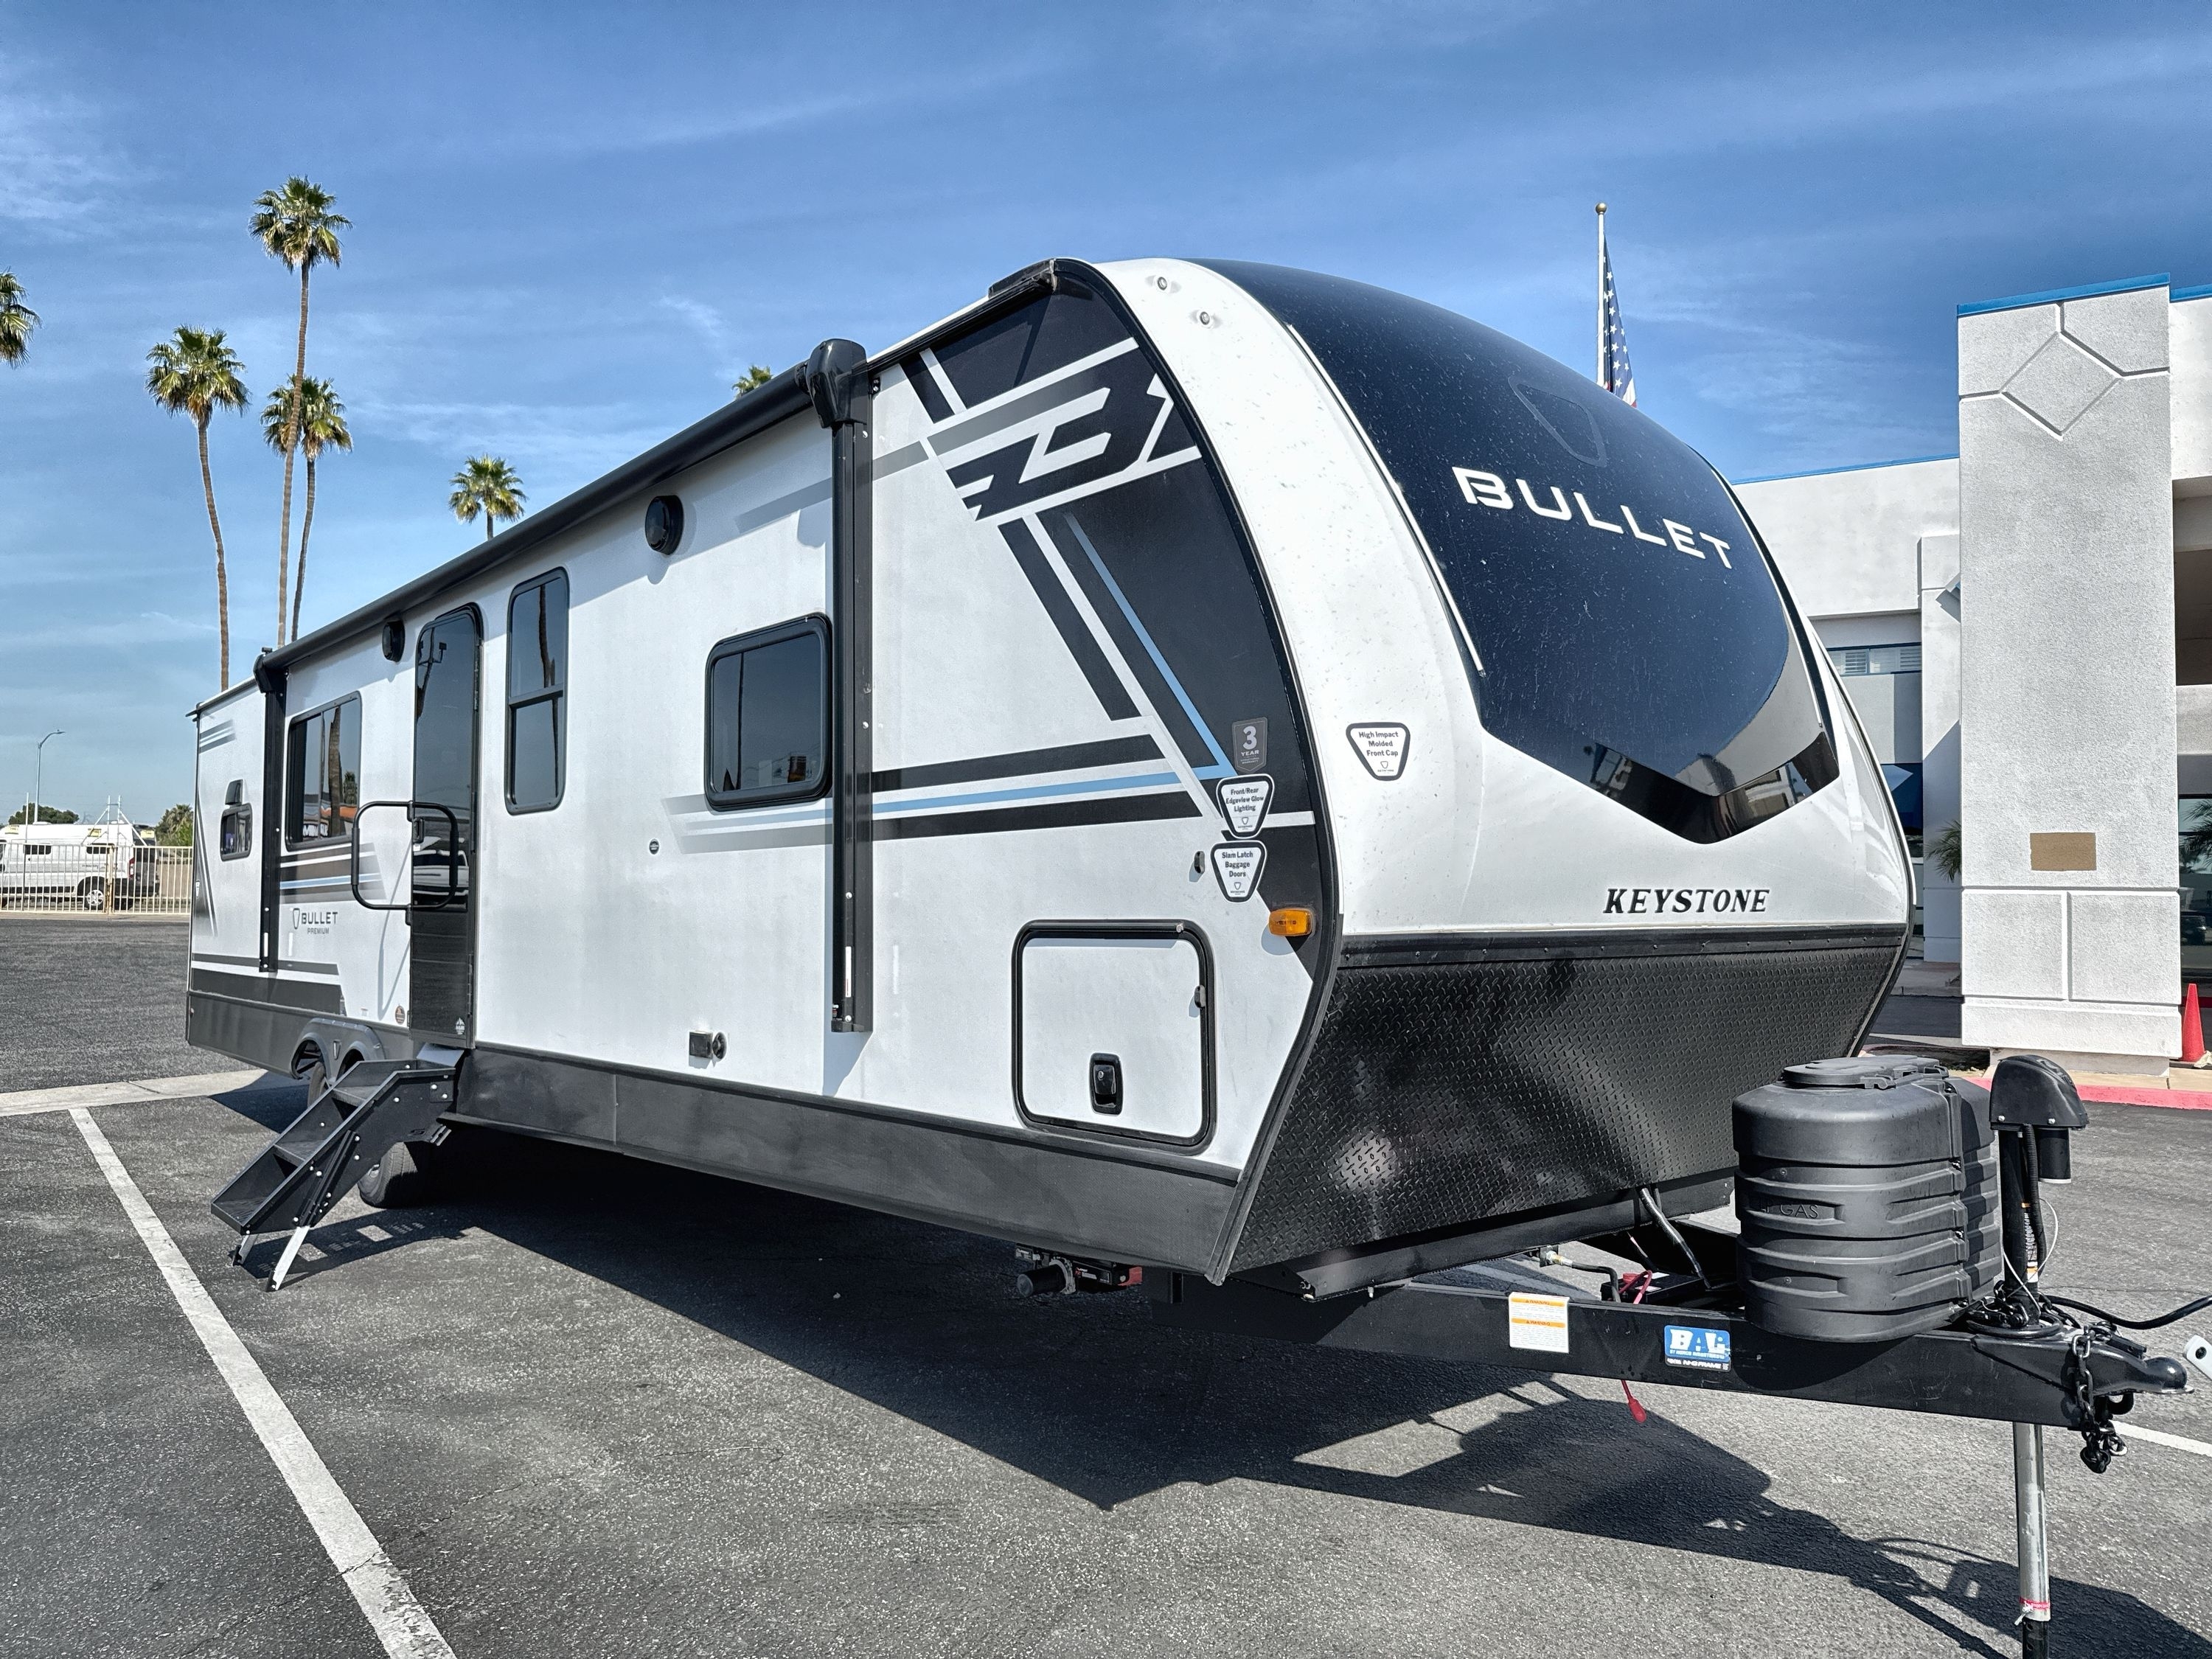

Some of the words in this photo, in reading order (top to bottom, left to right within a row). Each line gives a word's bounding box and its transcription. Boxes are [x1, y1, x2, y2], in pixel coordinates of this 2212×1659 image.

[1452, 466, 1732, 569] BULLET
[1242, 726, 1257, 750] 3
[1375, 731, 1399, 739] Impact
[1231, 787, 1259, 796] Front/Rear
[1225, 861, 1251, 869] Baggage
[1602, 888, 1770, 914] KEYSTONE
[302, 911, 338, 925] BULLET
[1779, 1203, 1819, 1219] GAS
